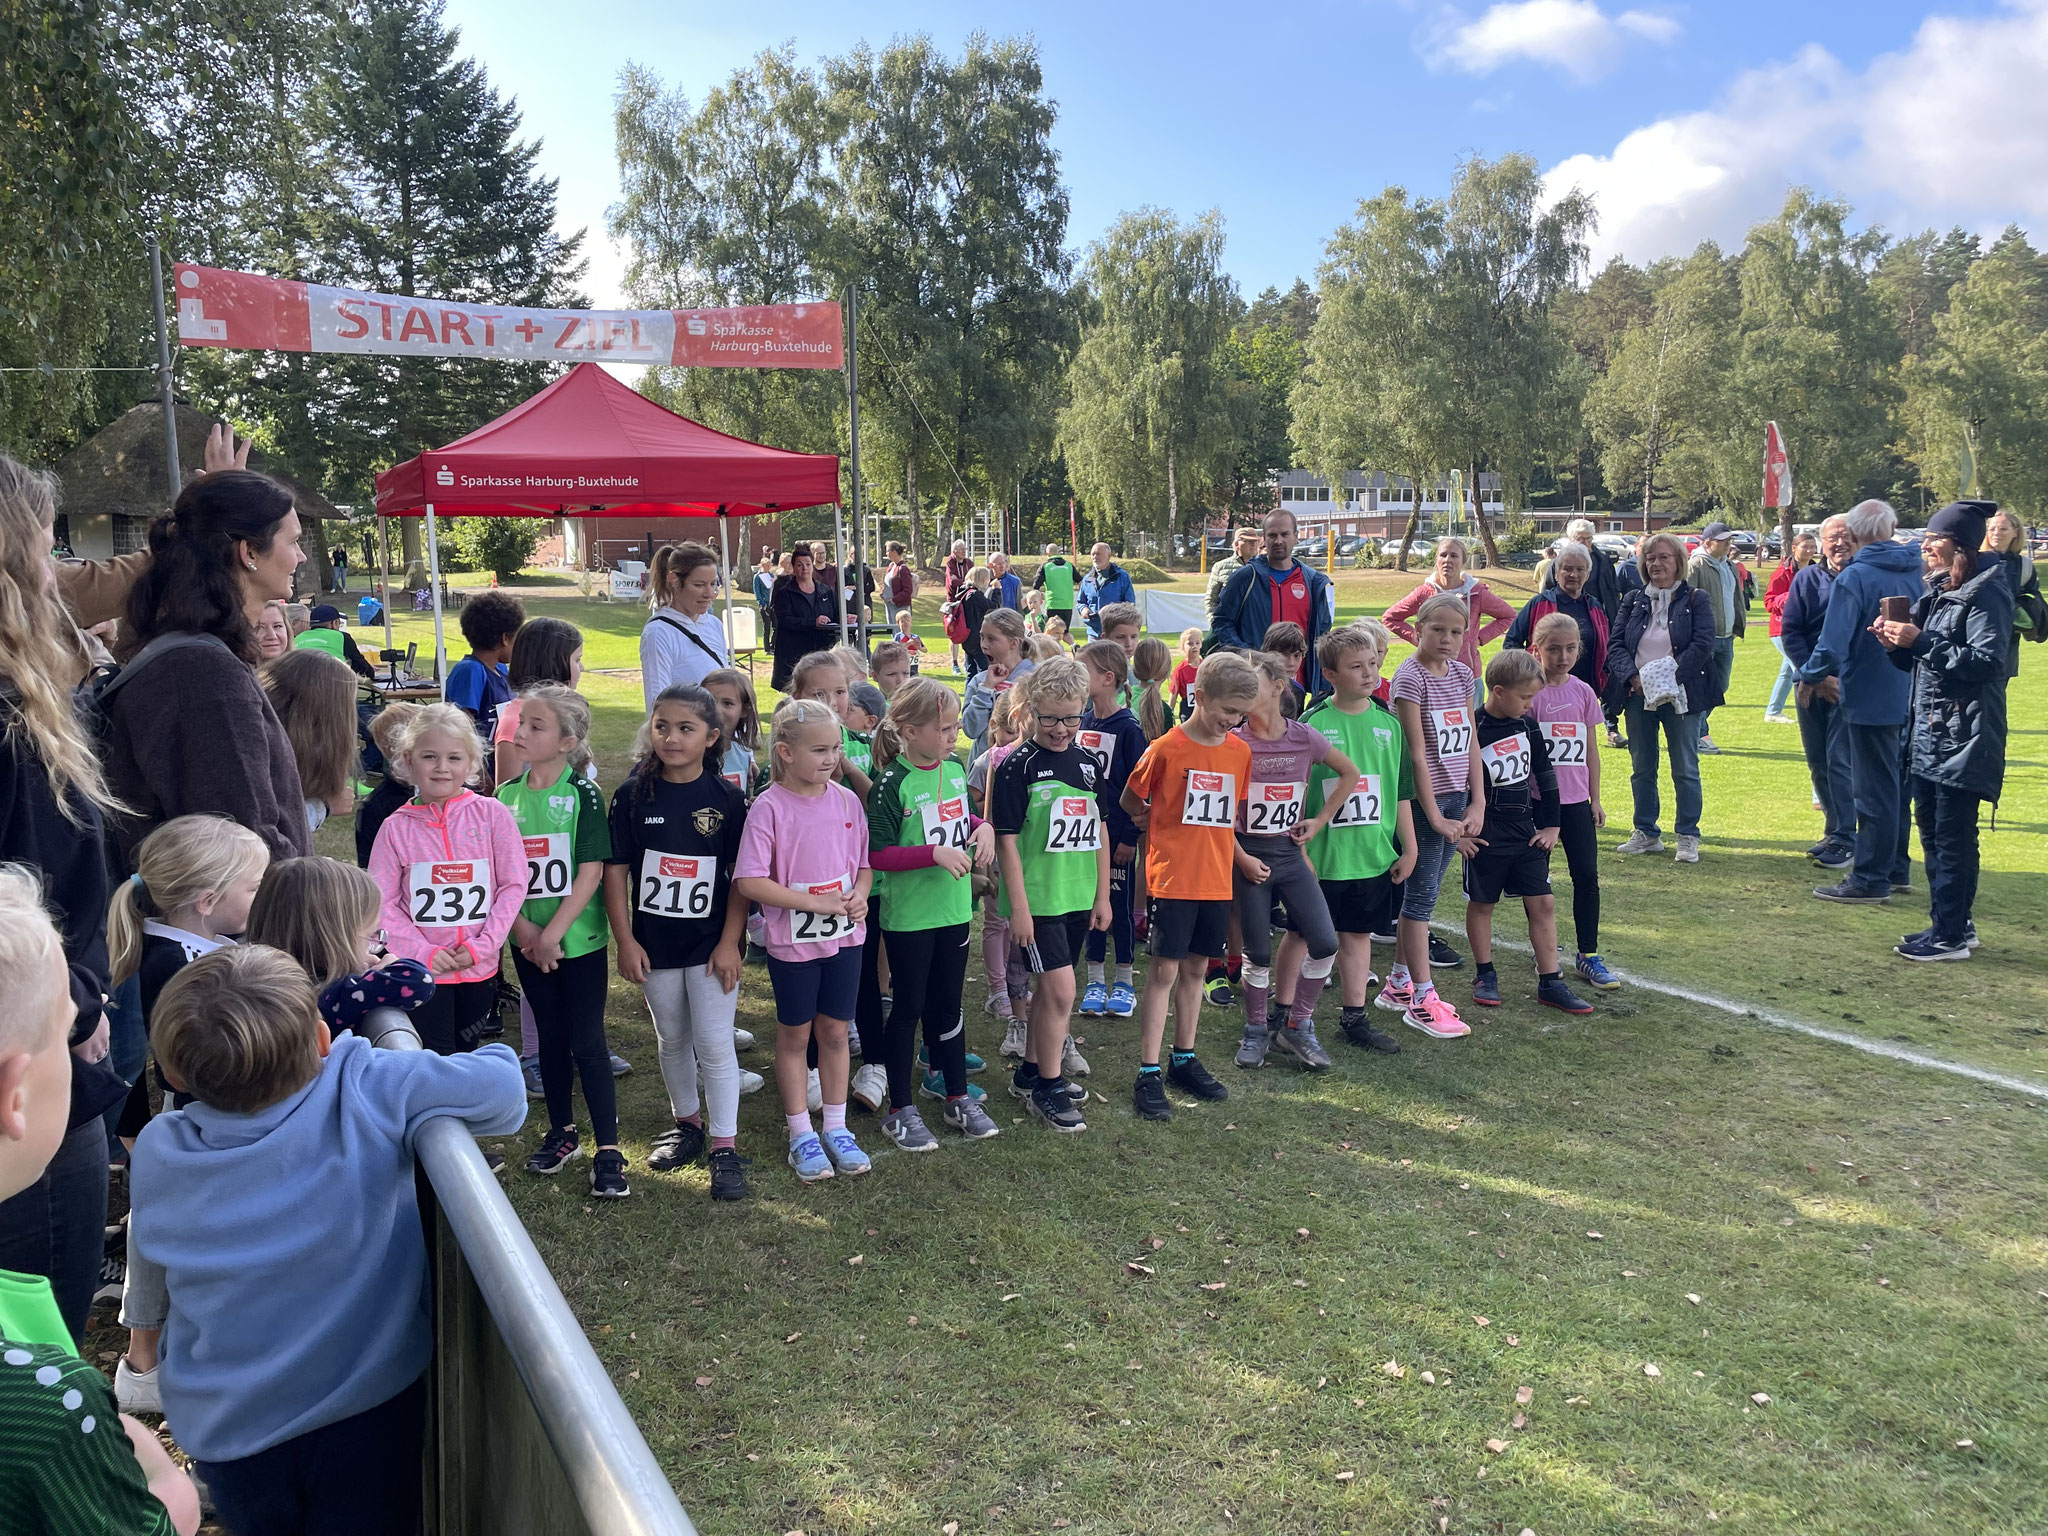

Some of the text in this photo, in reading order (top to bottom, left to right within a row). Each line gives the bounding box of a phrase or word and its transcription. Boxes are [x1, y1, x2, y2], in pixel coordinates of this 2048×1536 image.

[336, 299, 503, 347] START
[554, 316, 653, 351] ZIEL
[713, 323, 774, 337] Sparkasse
[710, 340, 833, 355] Harburg-Buxtehude
[460, 475, 639, 489] Sparkasse Harburg-Buxtehude
[1440, 726, 1471, 754] 227
[1544, 739, 1585, 763] 222
[1037, 769, 1054, 778] JAKO
[1490, 750, 1530, 784] 228
[914, 792, 930, 803] JAKO
[1332, 794, 1379, 824] 212
[644, 816, 665, 825] JAKO
[1250, 801, 1300, 830] 248
[1050, 818, 1096, 848] 244
[415, 885, 487, 922] 232
[643, 876, 709, 915] 216
